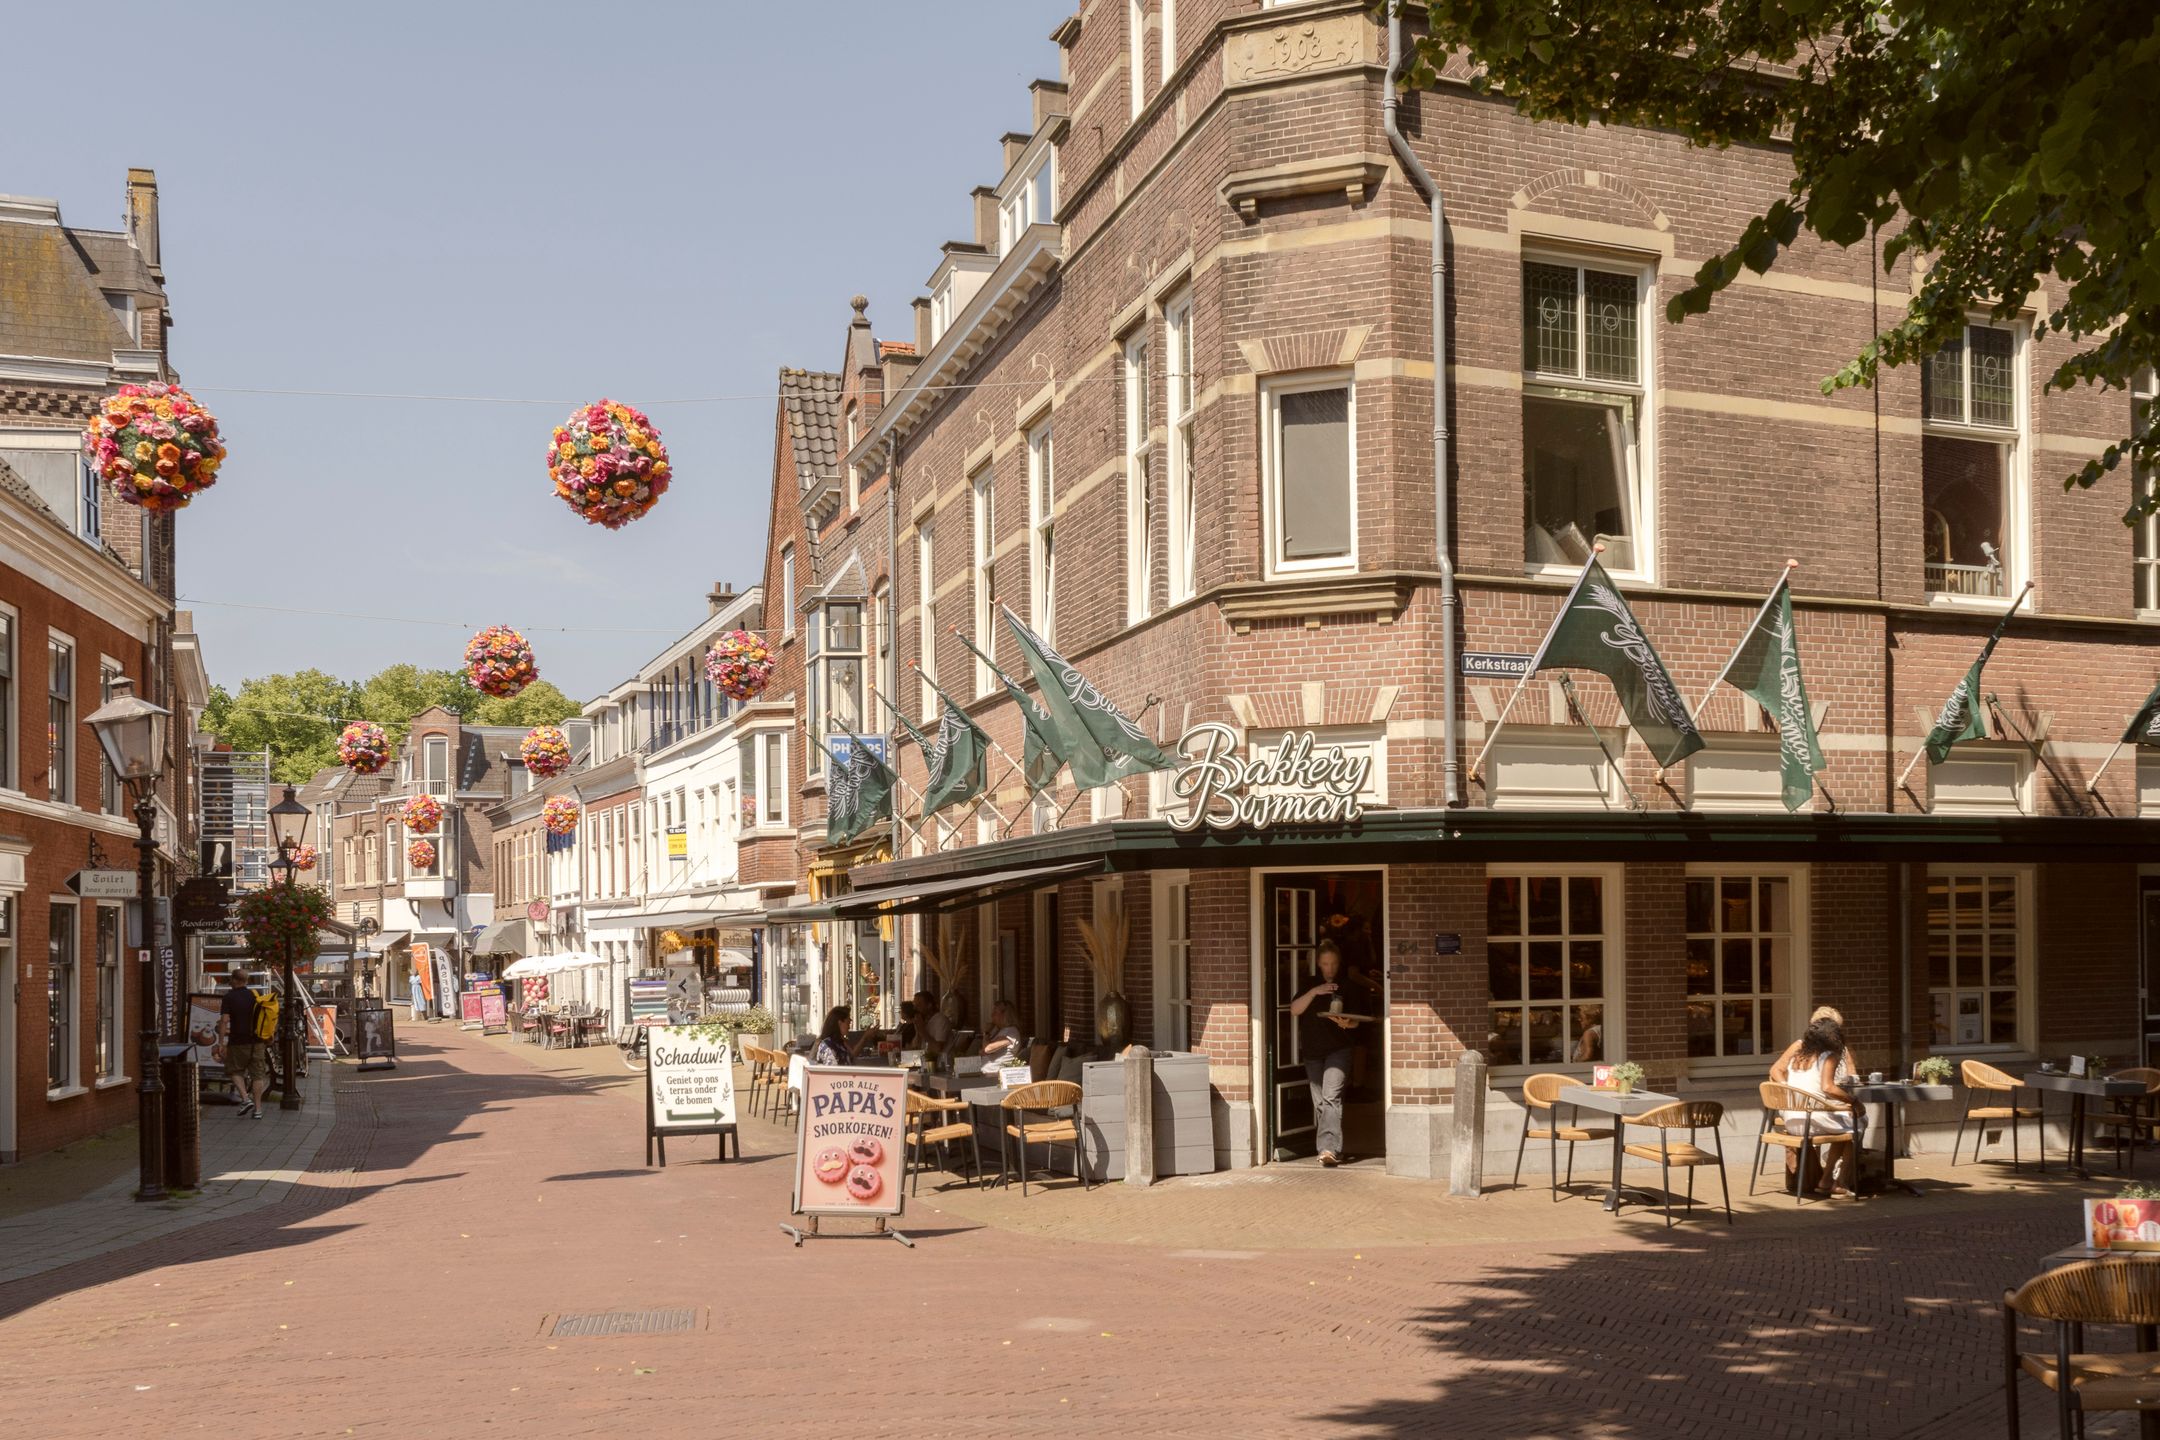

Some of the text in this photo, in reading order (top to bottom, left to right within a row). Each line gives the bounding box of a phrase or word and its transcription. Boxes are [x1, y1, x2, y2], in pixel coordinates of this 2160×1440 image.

[1269, 35, 1322, 65] 1908
[1465, 657, 1532, 672] Kerkstraat
[832, 743, 882, 754] PHPS
[1176, 721, 1372, 797] Bakkery
[1166, 761, 1364, 832] Bosman
[92, 874, 125, 884] Toilet
[105, 887, 133, 895] poortje
[180, 918, 224, 930] Roodenrijs
[654, 1044, 727, 1067] Schaduw?
[666, 1076, 719, 1085] Geniet op ons
[830, 1080, 880, 1092] VOOR ALLE
[669, 1085, 717, 1095] terras onder
[675, 1096, 713, 1105] de bomen
[811, 1091, 897, 1119] PAPA'S
[813, 1122, 894, 1139] SNORKOEKEN!
